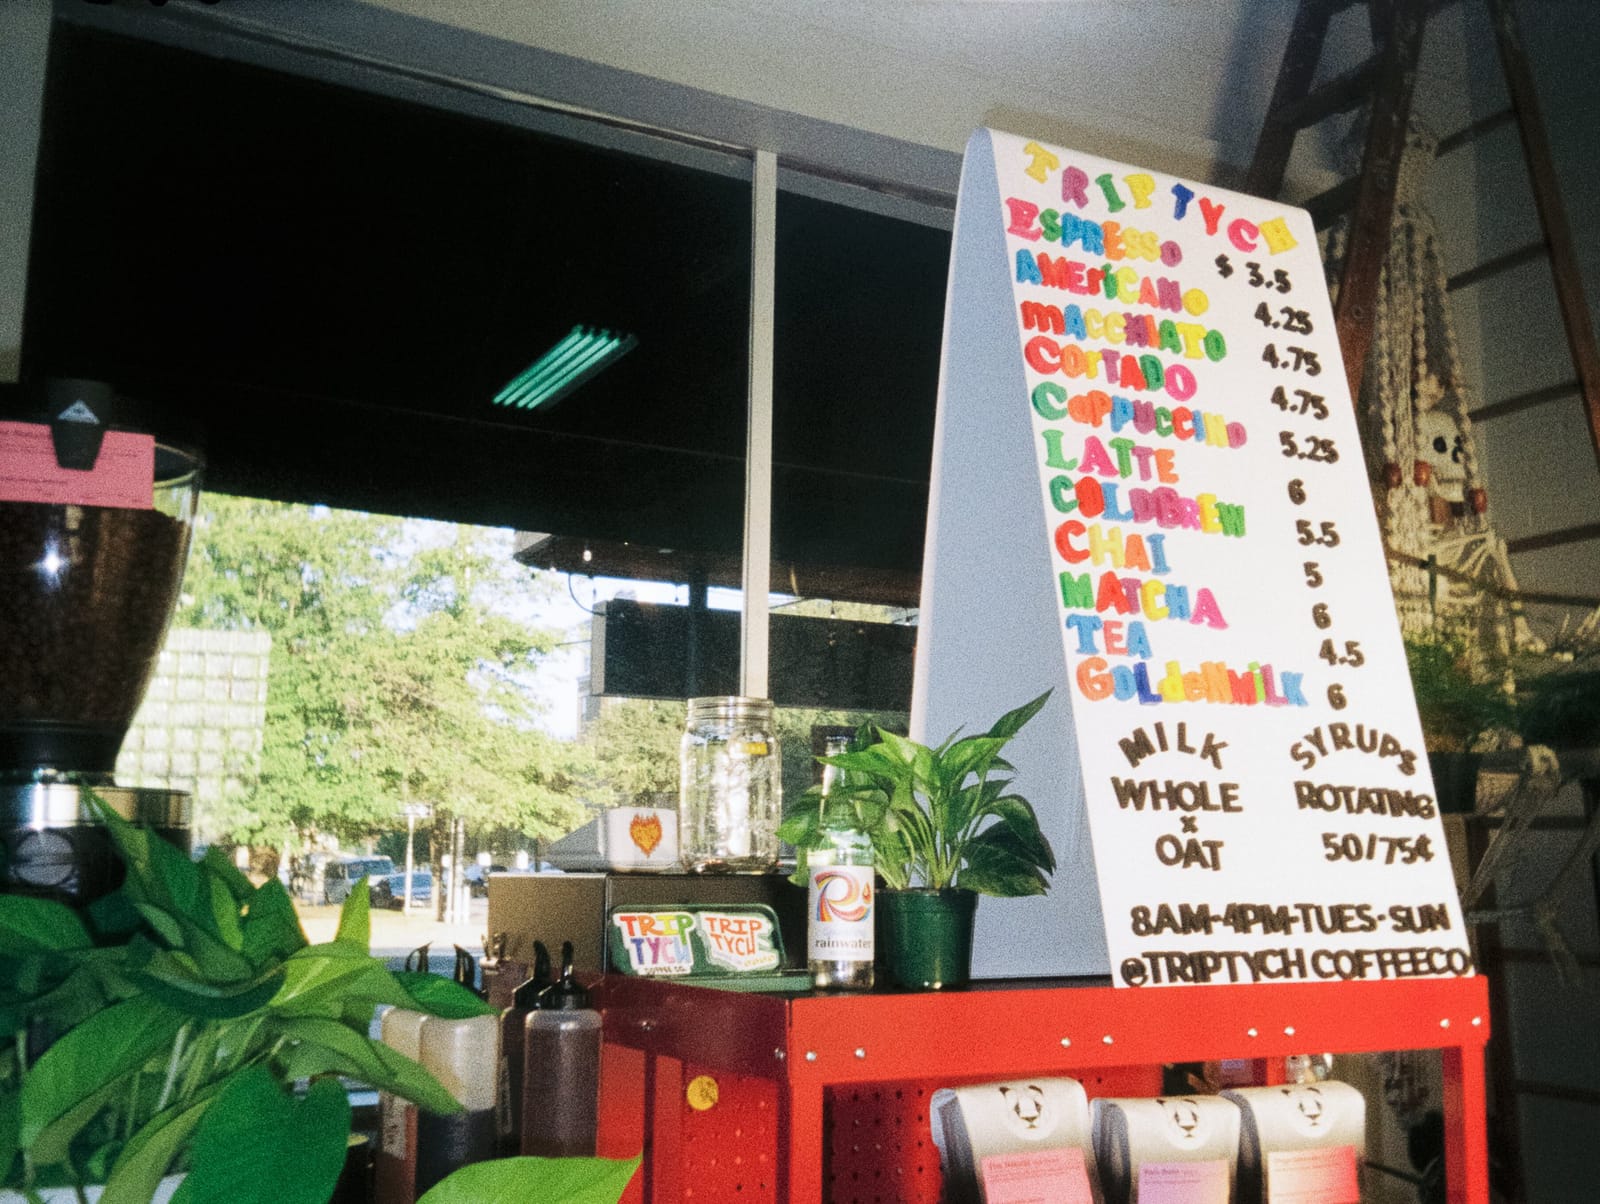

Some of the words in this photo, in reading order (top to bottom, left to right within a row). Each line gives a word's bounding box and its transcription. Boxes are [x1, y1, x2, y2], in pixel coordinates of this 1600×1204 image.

[1023, 140, 1156, 213] TRIP
[1171, 183, 1299, 255] TYCH
[1005, 197, 1182, 267] ESPRESSO
[1246, 262, 1292, 293] 3.5
[1254, 302, 1313, 335] 4.25
[1262, 344, 1321, 376] 4.75
[1271, 386, 1329, 420] 4.75
[1279, 431, 1340, 464] 5.25
[1042, 430, 1180, 484] LATTE
[1288, 479, 1306, 505] 6
[1296, 519, 1341, 548] 5.5
[1054, 520, 1171, 576] CHAI
[1304, 561, 1323, 588] 5
[1059, 571, 1229, 629] MATCHA
[1312, 603, 1332, 629] 6
[1066, 614, 1153, 659] TEA
[1319, 639, 1365, 667] 4.5
[1327, 683, 1347, 710] 6
[1118, 722, 1229, 769] MILK
[1290, 722, 1418, 776] SYRUPS
[1110, 776, 1243, 813] WHOLE
[1293, 780, 1436, 819] ROTATING
[1155, 833, 1224, 871] OAT
[620, 915, 694, 946] TRIP
[705, 917, 762, 935] TRIP
[815, 937, 871, 949] rainwater
[630, 936, 691, 965] TYCH
[711, 933, 756, 956] TYCH
